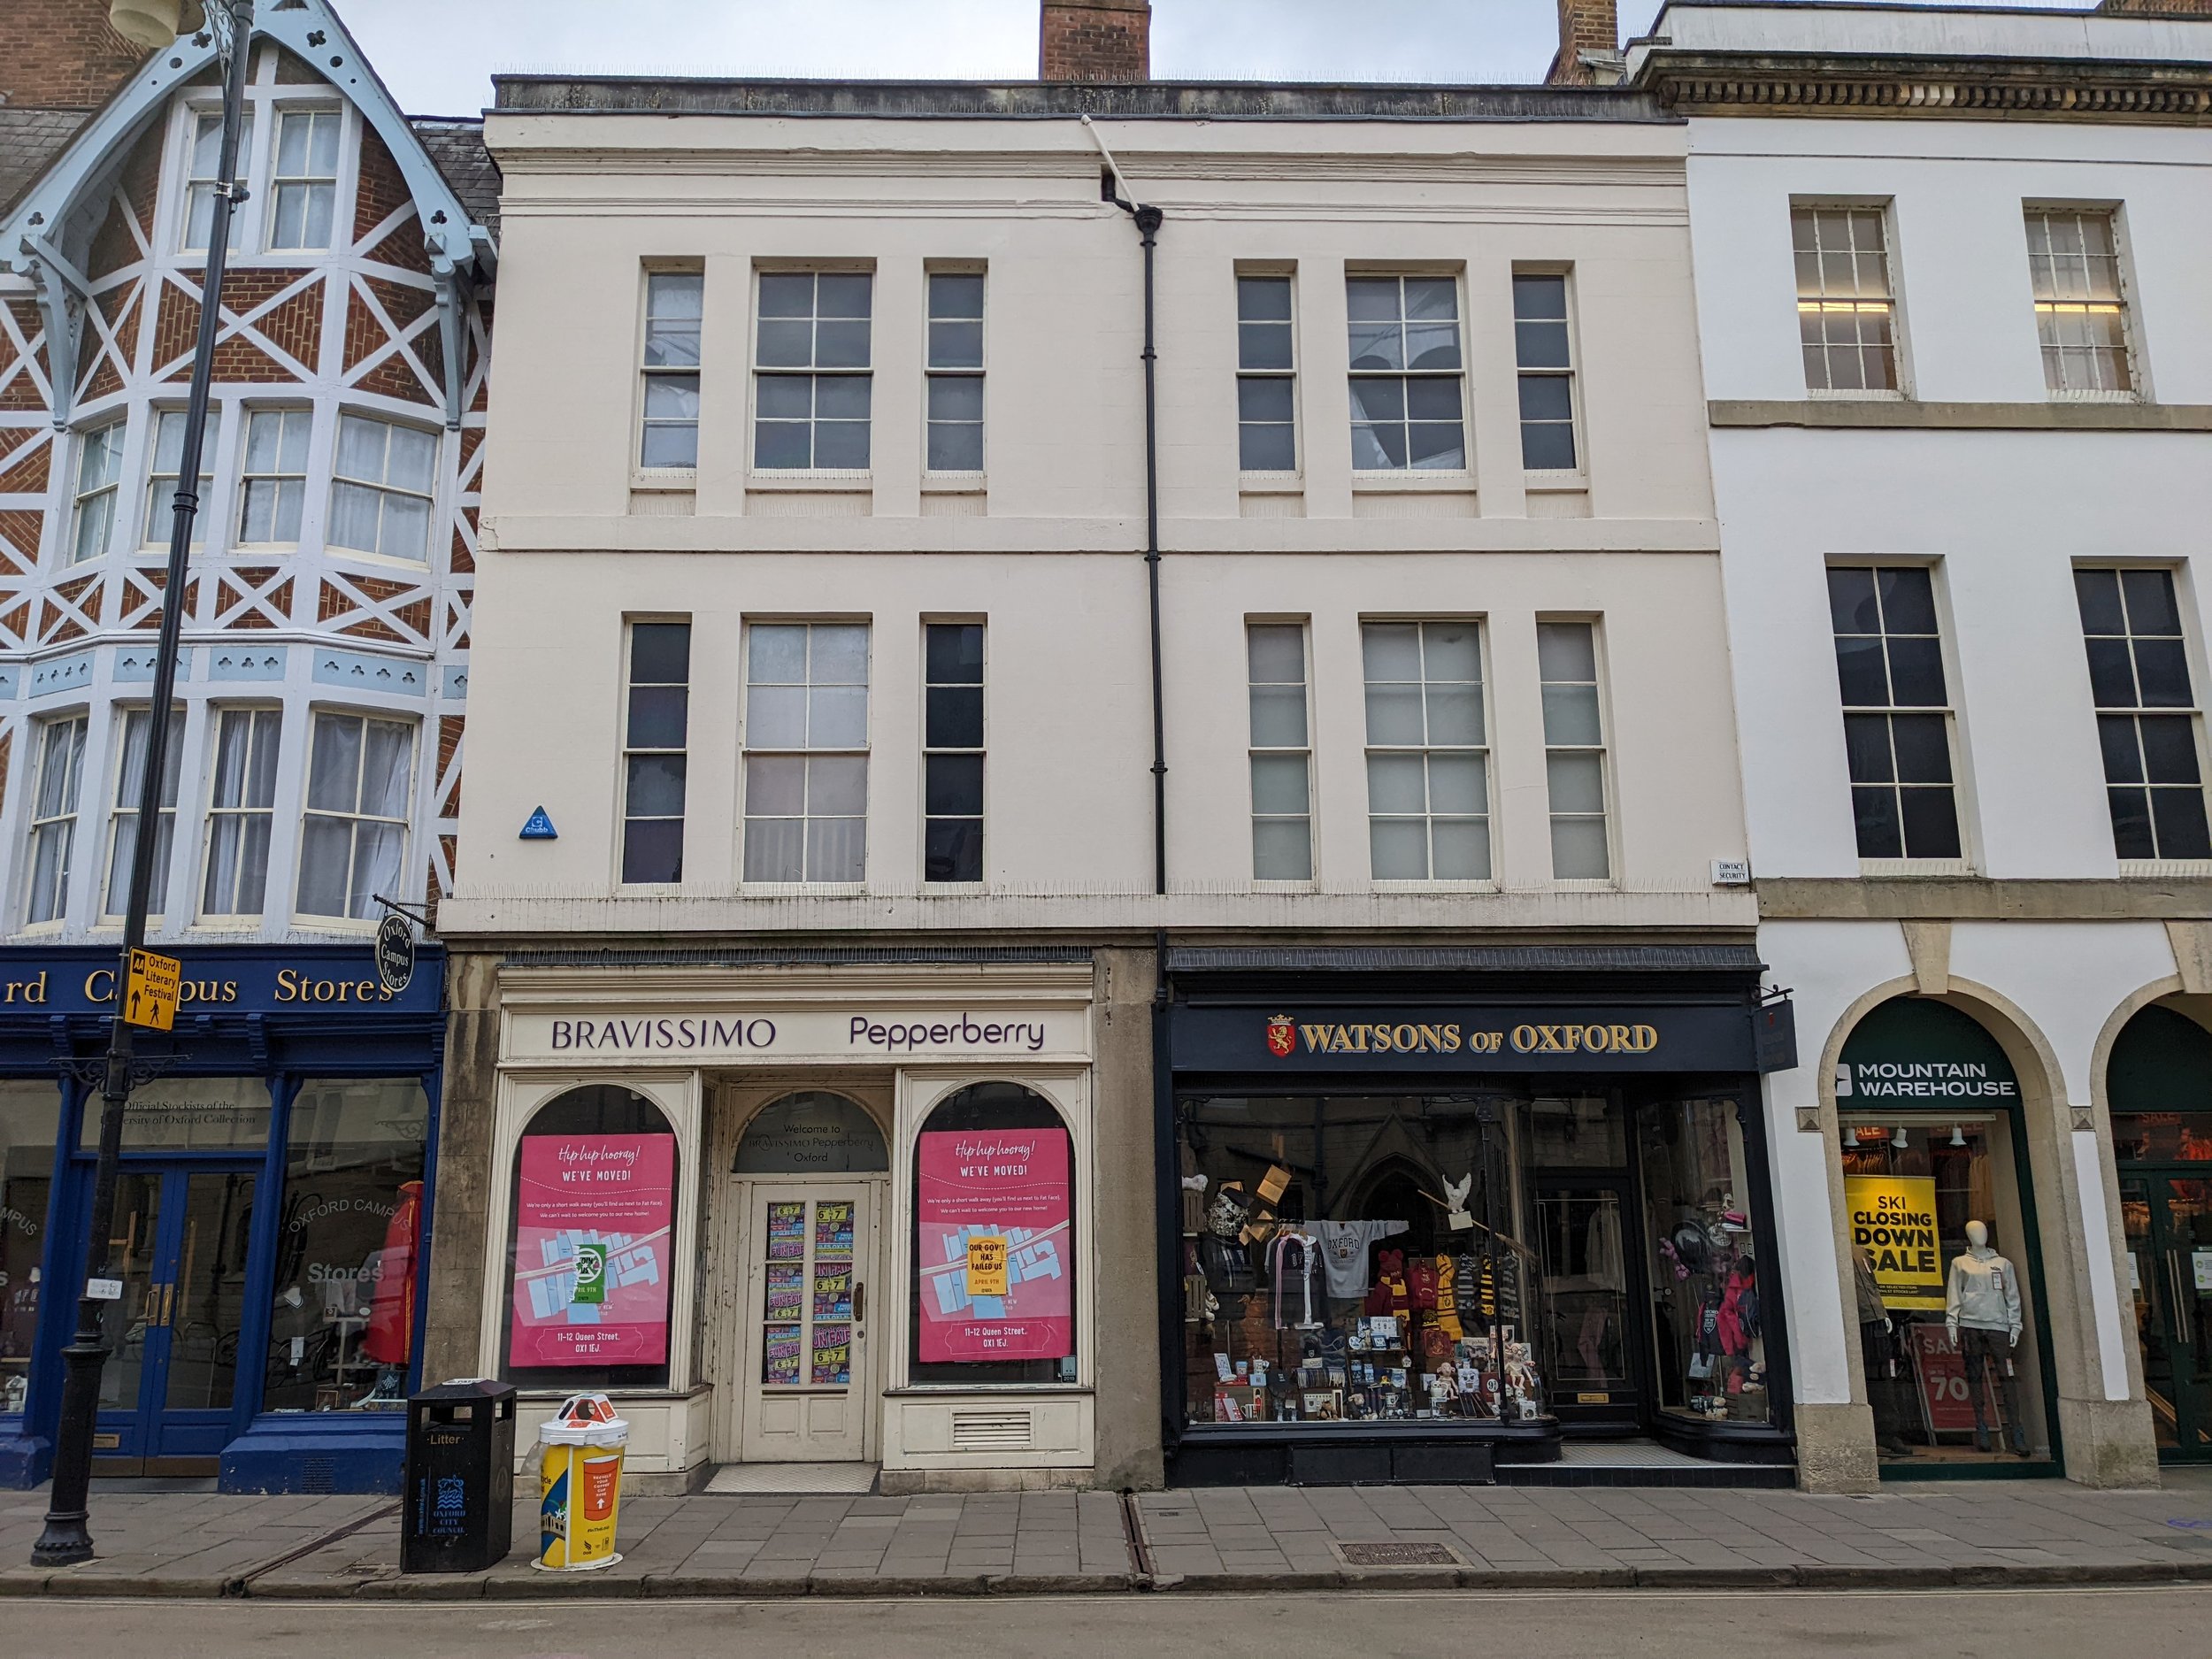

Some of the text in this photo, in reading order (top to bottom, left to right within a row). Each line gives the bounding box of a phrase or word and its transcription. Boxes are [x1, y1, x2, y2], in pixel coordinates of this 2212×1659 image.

[383, 920, 411, 949] Oxford
[380, 943, 410, 967] Campus
[134, 957, 145, 971] AA
[149, 956, 177, 972] Oxford
[145, 972, 177, 990] Literary
[382, 961, 409, 987] Stores
[84, 970, 238, 1012] Cpus
[274, 969, 394, 1002] Stores
[144, 985, 175, 1002] Festival
[551, 1011, 1045, 1052] BRAVISSIMO Pepperberry
[1298, 1023, 1462, 1054] WATSONS
[1509, 1023, 1659, 1054] OXFORD
[1857, 1063, 1987, 1079] MOUNTAIN
[1858, 1081, 2016, 1097] WAREHOUSE
[162, 1100, 204, 1111] Stockists
[206, 1100, 219, 1111] of
[219, 1101, 235, 1110] the
[152, 1112, 257, 1125] of Oxford Collection
[783, 1124, 841, 1133] Welcome to
[1855, 1125, 1881, 1137] ALE
[812, 1137, 873, 1151] Pepperberry
[956, 1139, 1035, 1162] Hip hip hooray!
[558, 1143, 641, 1167] Hip hip hooray!
[794, 1152, 828, 1162] Oxford
[562, 1170, 631, 1182] WE'VE MOVED!
[960, 1164, 1027, 1177] WE'VE MOVED!
[1878, 1195, 1906, 1210] SKI
[288, 1198, 411, 1233] OXFORD CAMPUS
[818, 1210, 841, 1219] 6 7
[1853, 1210, 1932, 1227] CLOSING
[1327, 1237, 1360, 1250] OXFORD
[1854, 1227, 1934, 1248] DOWN
[771, 1246, 787, 1256] FUN
[306, 1262, 385, 1284] Stores
[557, 1333, 573, 1341] 11-12
[575, 1332, 595, 1341] Queen
[964, 1327, 980, 1336] 11-12
[982, 1327, 1002, 1336] Queen
[1923, 1338, 1962, 1355] SAL
[1930, 1376, 1970, 1402] 70
[430, 1434, 461, 1445] Litter
